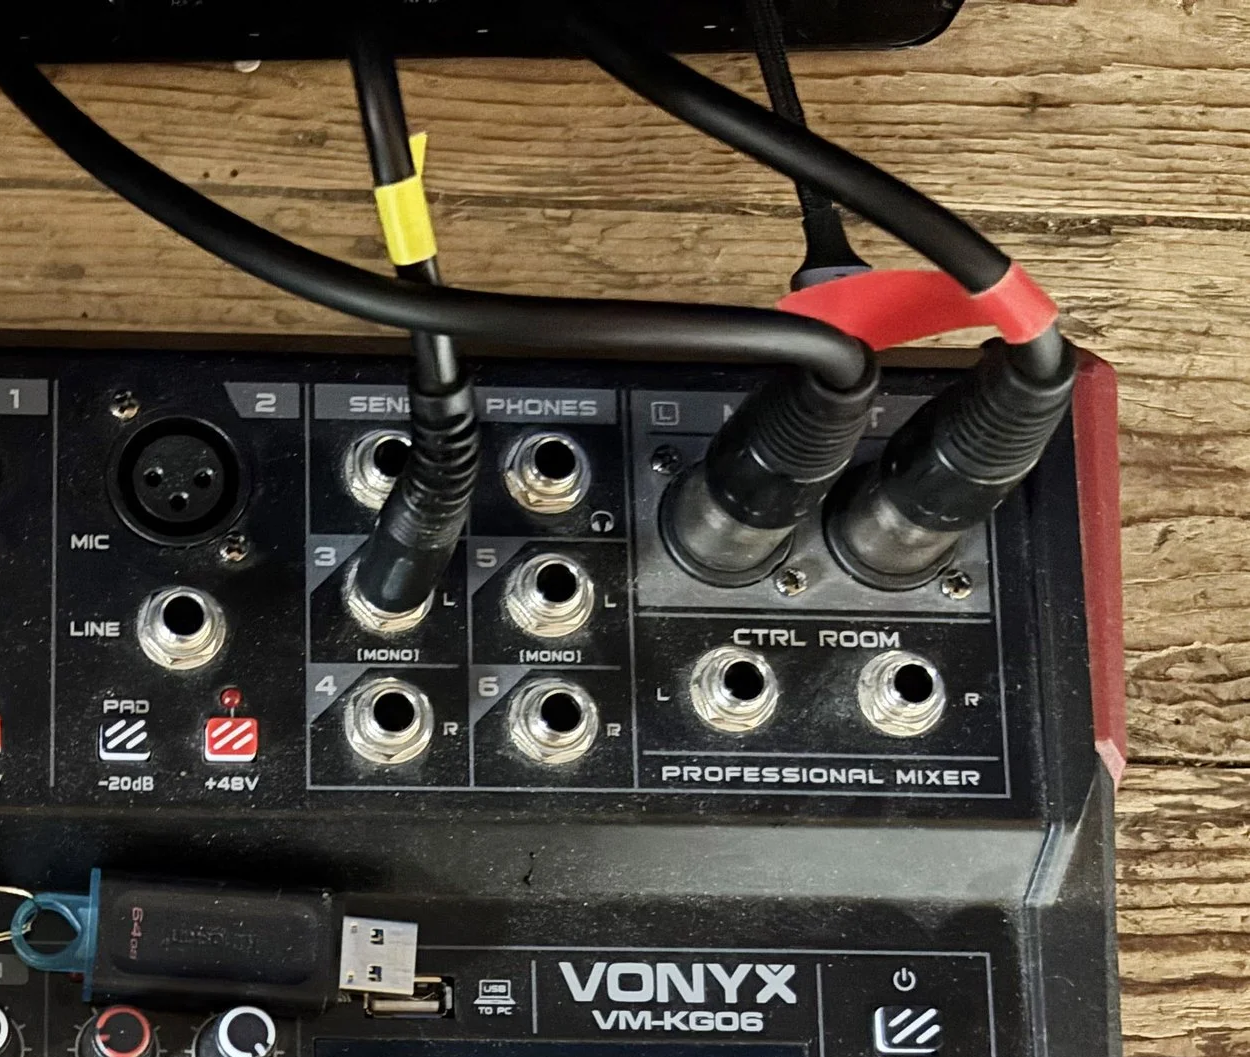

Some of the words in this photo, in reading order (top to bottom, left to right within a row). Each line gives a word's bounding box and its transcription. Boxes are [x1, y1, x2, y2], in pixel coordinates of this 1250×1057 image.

[7, 389, 20, 408] 1
[255, 393, 277, 412] 2
[486, 398, 598, 416] PHONES
[71, 534, 110, 550] MIC
[314, 547, 336, 566] 3
[476, 548, 497, 568] 5
[70, 622, 120, 638] LINE
[733, 628, 806, 647] CTRL
[819, 630, 900, 648] ROOM
[314, 676, 337, 696] 4
[478, 677, 499, 696] 6
[103, 699, 150, 714] PAD
[98, 776, 153, 792] -20dB
[205, 776, 259, 792] +48V
[661, 765, 884, 784] PROFESSIONAL
[896, 769, 981, 786] MIXER
[483, 985, 507, 993] USB
[558, 961, 797, 1004] VONYX
[478, 1006, 493, 1015] TO
[496, 1006, 513, 1015] PC
[592, 1009, 763, 1032] VM-KG06
